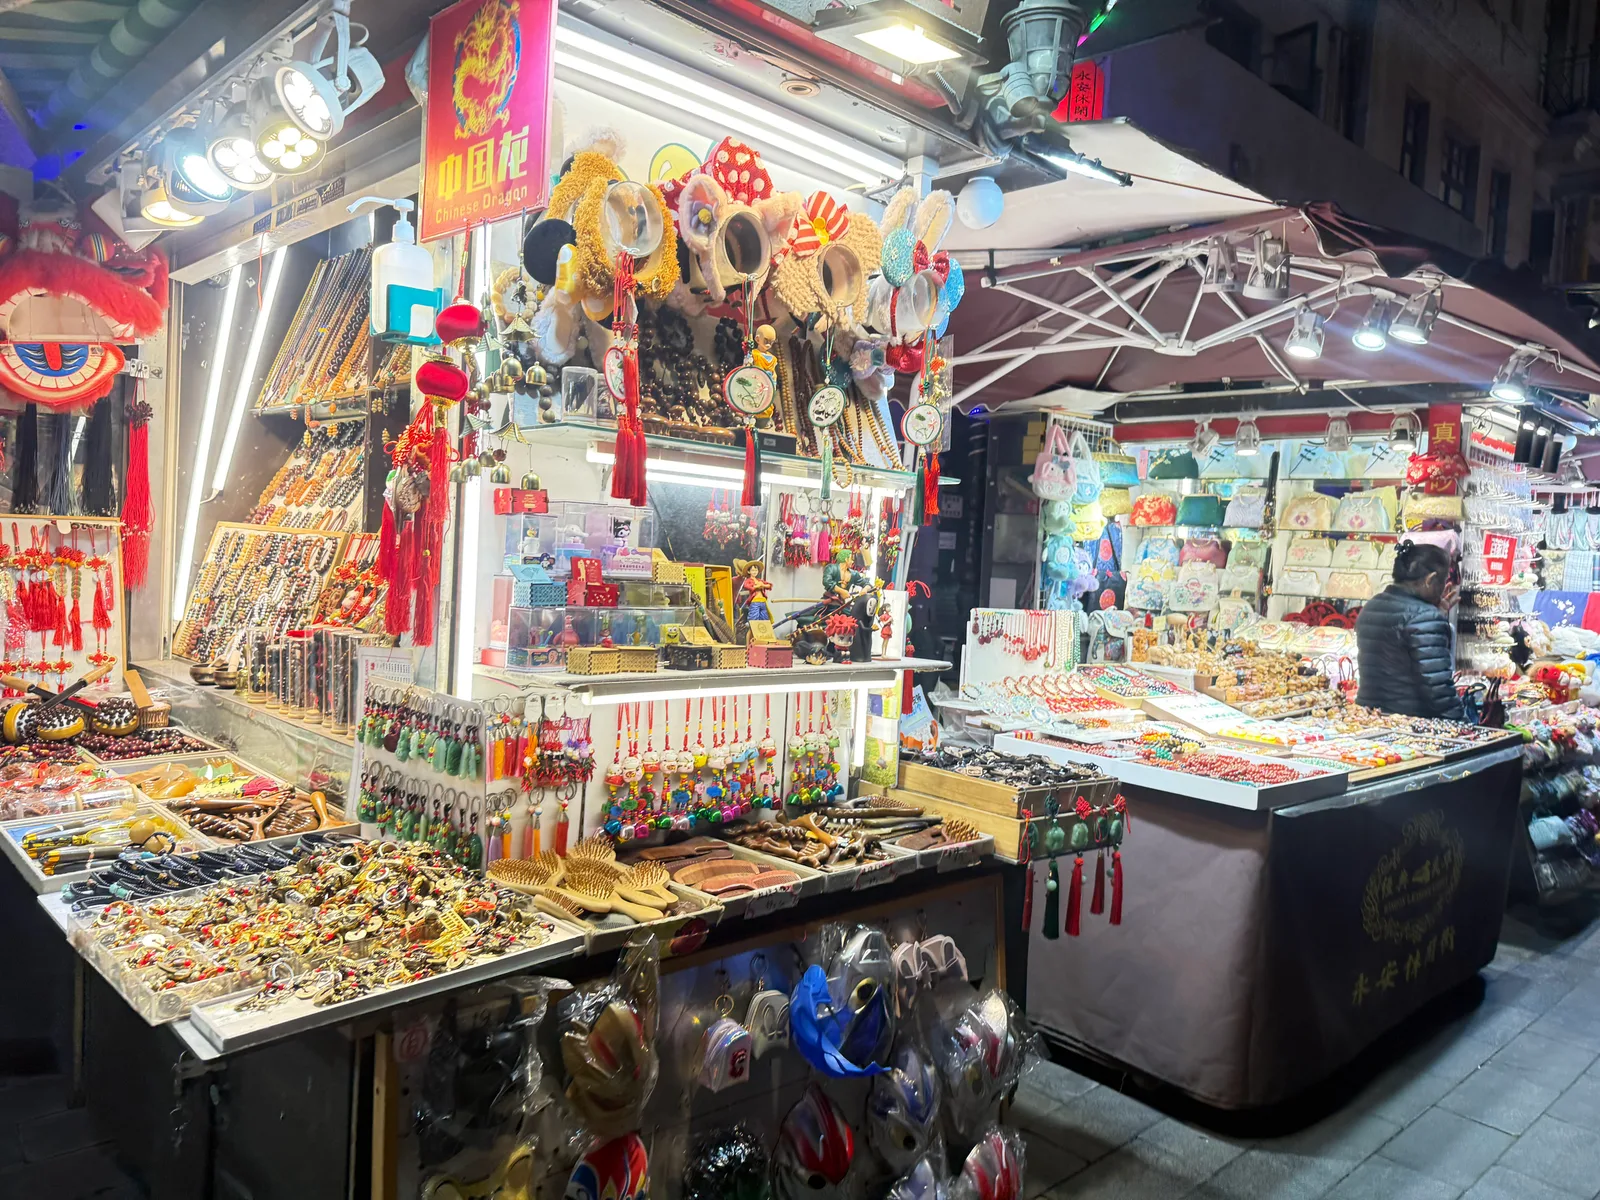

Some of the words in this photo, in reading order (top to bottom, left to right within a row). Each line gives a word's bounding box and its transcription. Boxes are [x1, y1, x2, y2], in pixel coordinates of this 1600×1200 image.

[437, 124, 530, 201] 中国龙
[435, 200, 480, 224] Chinese
[482, 185, 528, 209] Dragon
